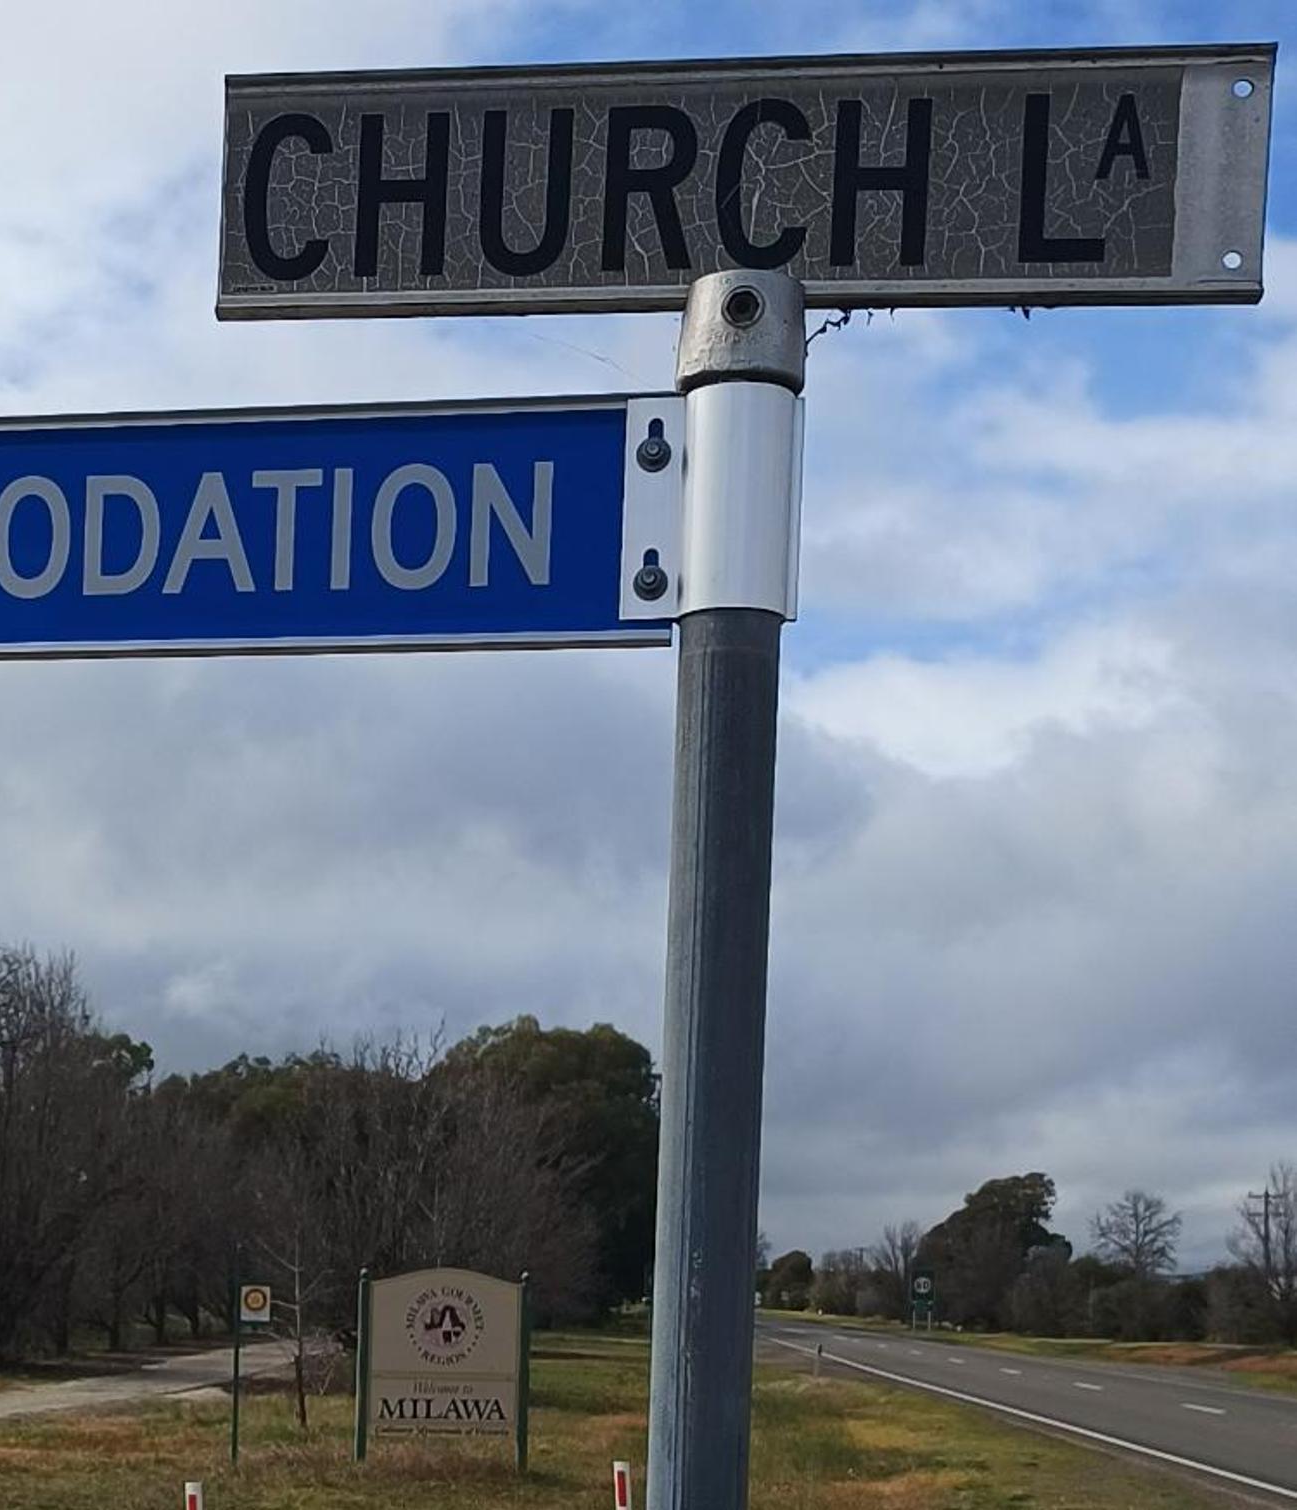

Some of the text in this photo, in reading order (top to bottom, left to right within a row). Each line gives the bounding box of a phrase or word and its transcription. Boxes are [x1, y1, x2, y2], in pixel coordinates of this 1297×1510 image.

[242, 92, 1152, 282] CHURCH LA
[406, 1288, 438, 1329] MILAWA
[378, 1397, 506, 1420] MILAWA
